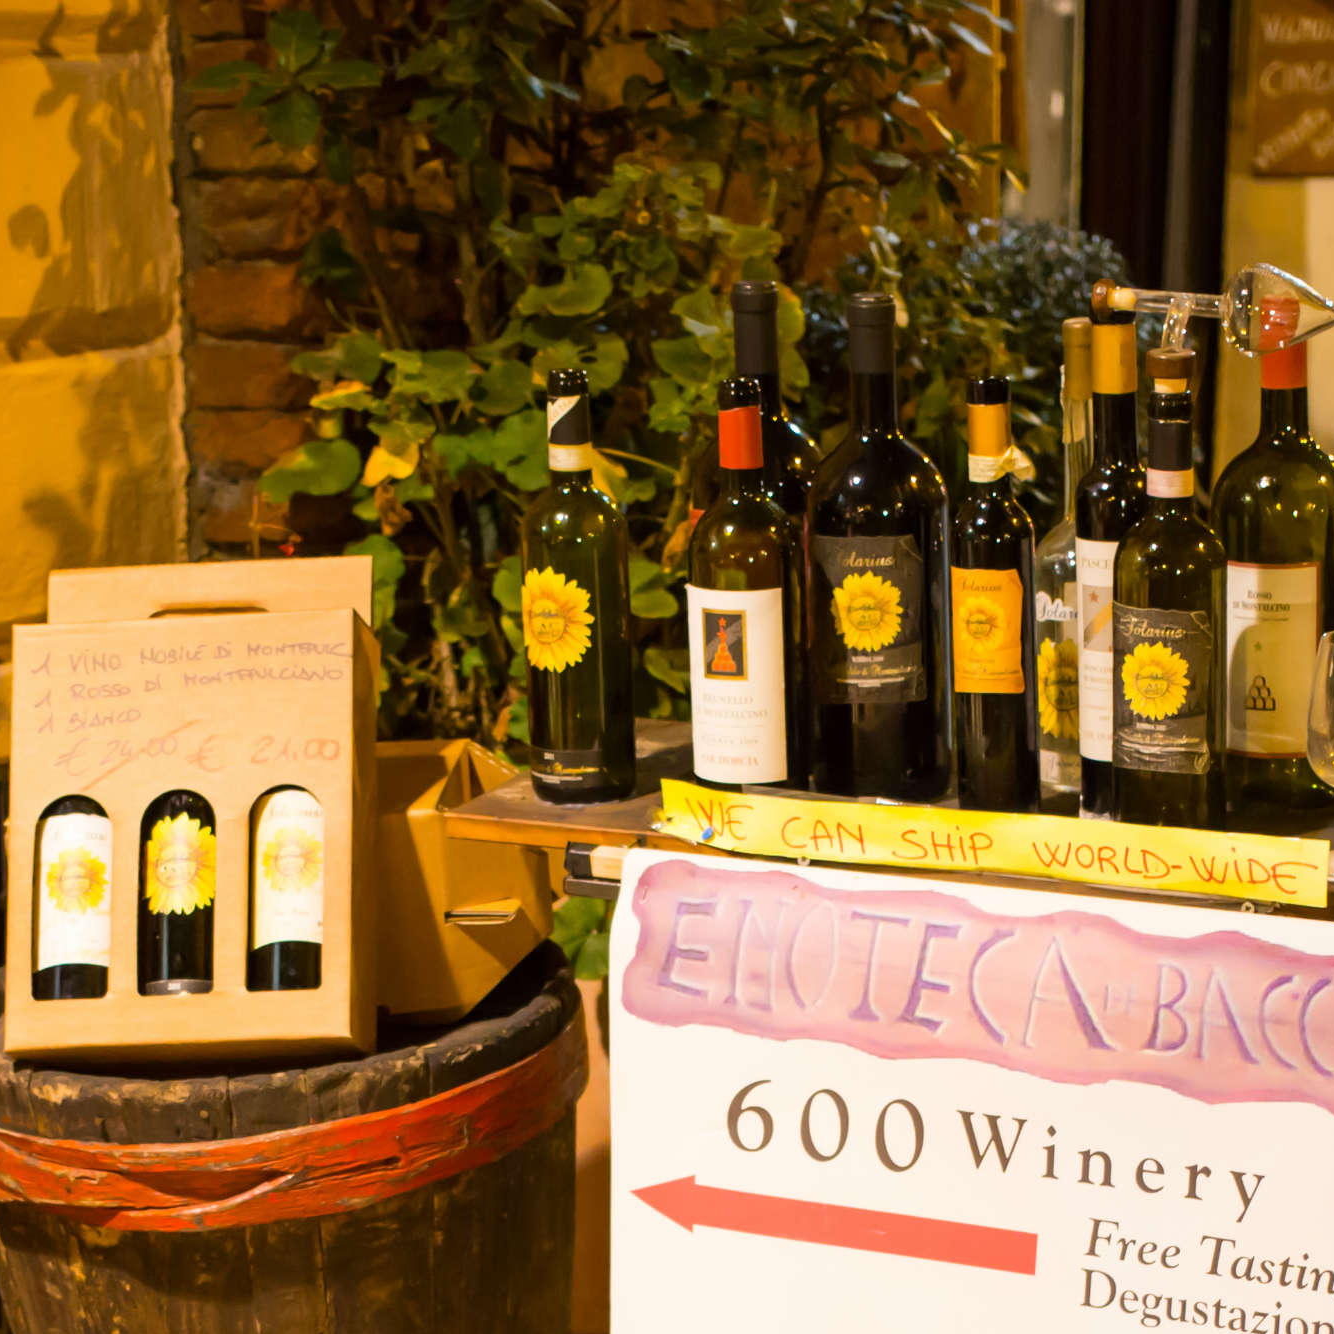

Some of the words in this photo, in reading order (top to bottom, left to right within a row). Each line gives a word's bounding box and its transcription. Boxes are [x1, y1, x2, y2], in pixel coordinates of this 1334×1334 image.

[683, 797, 754, 842] WE
[782, 816, 867, 856] CAN
[892, 824, 995, 867] SHIP
[1032, 841, 1318, 896] WORLD-WIDE
[726, 1078, 927, 1173] 600
[956, 1107, 1266, 1224] Winery
[1084, 1217, 1182, 1270] Free
